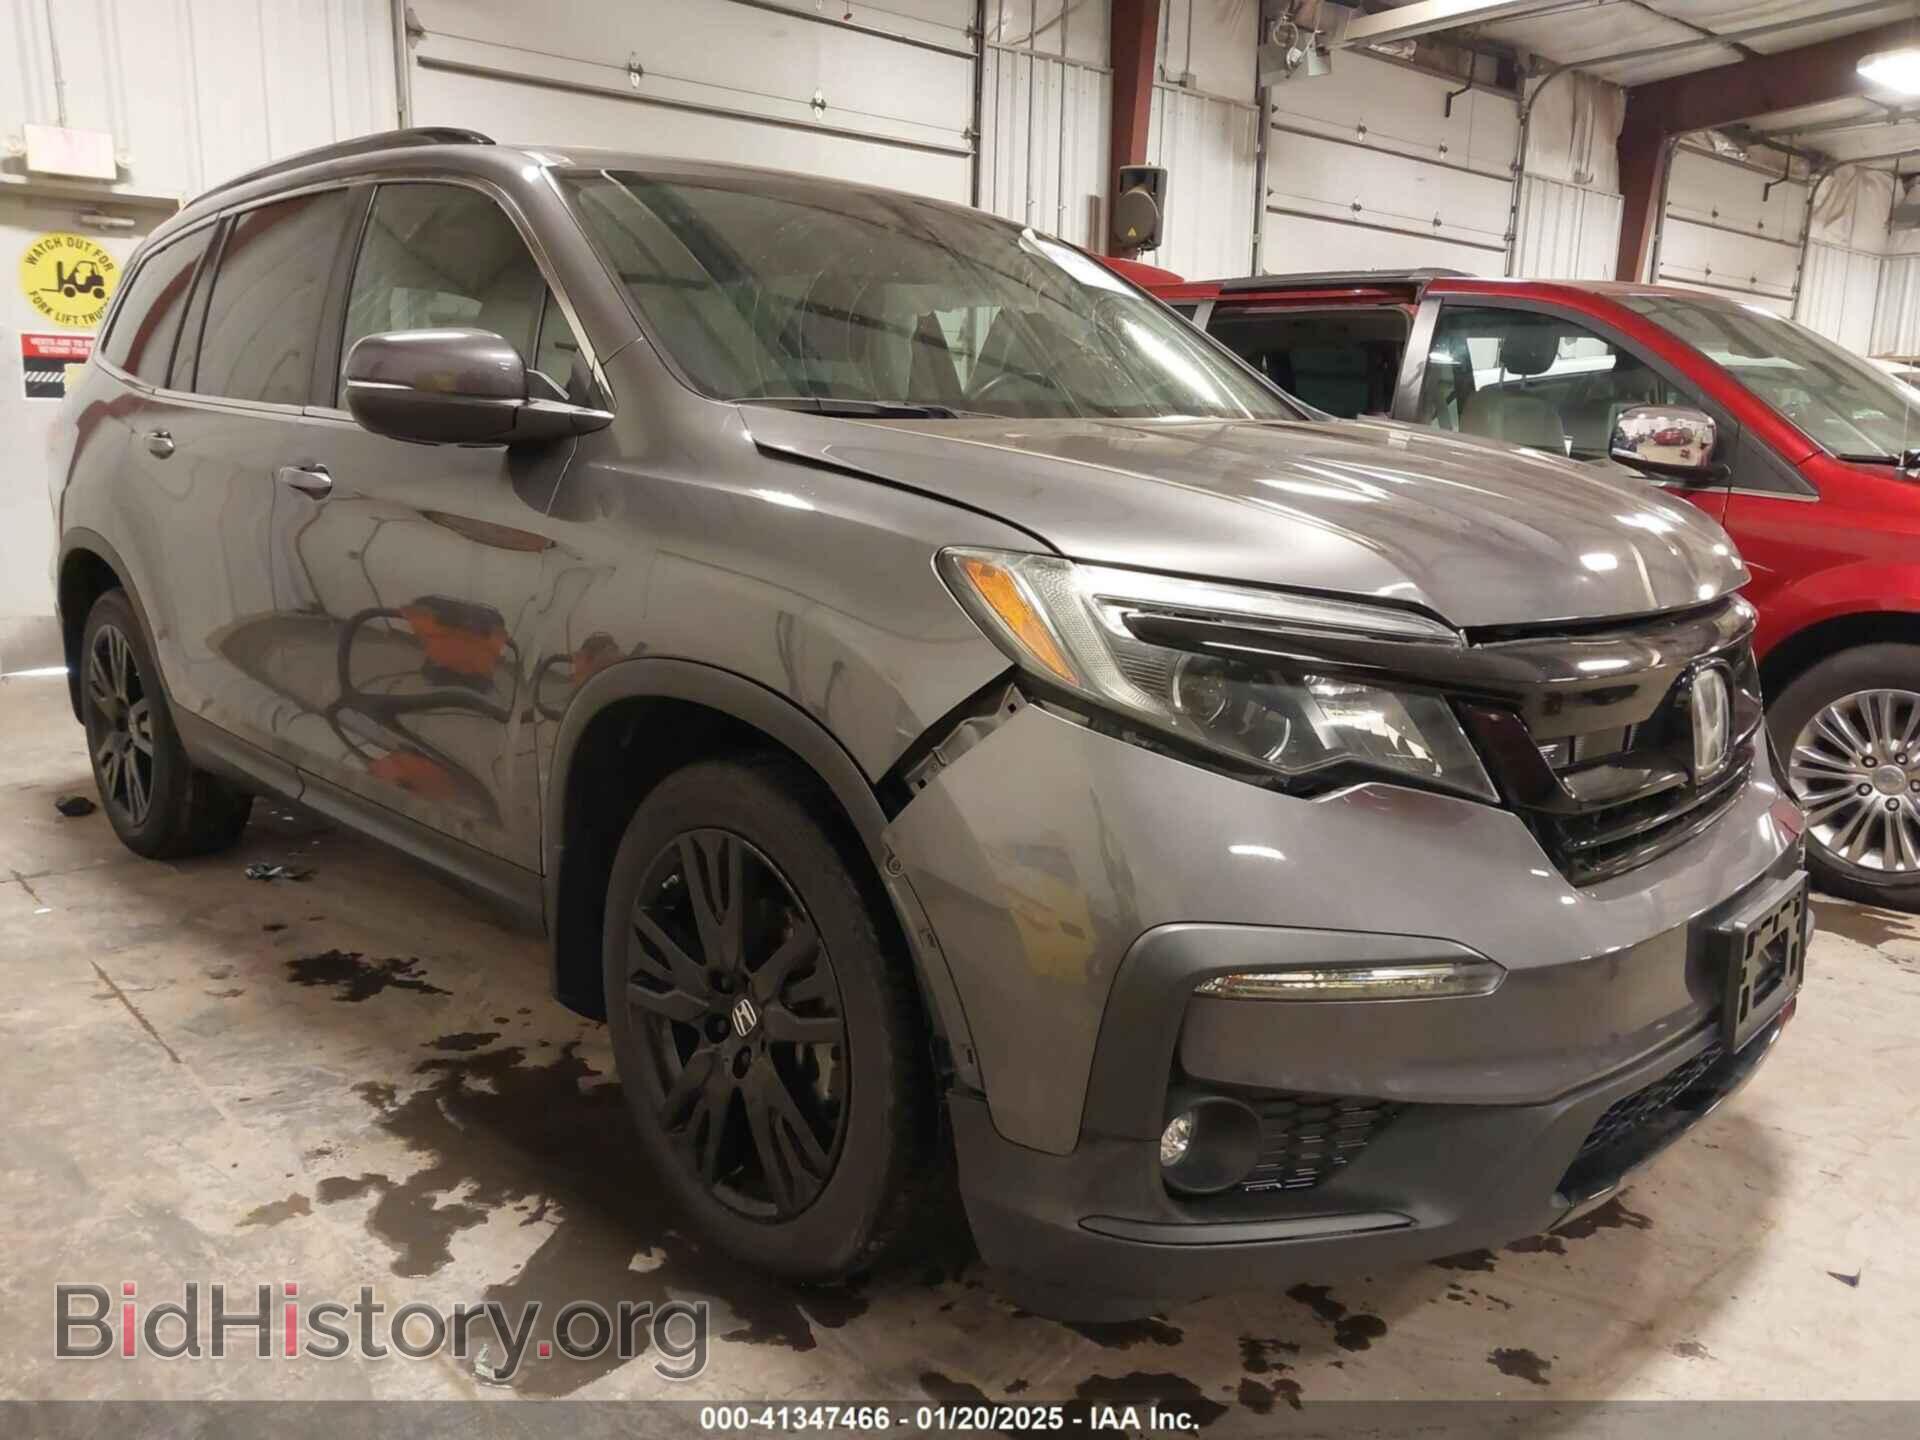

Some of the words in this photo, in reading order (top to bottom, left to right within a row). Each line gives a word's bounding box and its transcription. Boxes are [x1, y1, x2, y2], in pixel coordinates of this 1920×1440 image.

[26, 237, 62, 265] WATCH
[67, 237, 92, 251] OUT
[93, 248, 114, 272] FOR
[29, 290, 54, 315] FORK
[54, 312, 79, 325] LIFT
[81, 297, 111, 325] TRU
